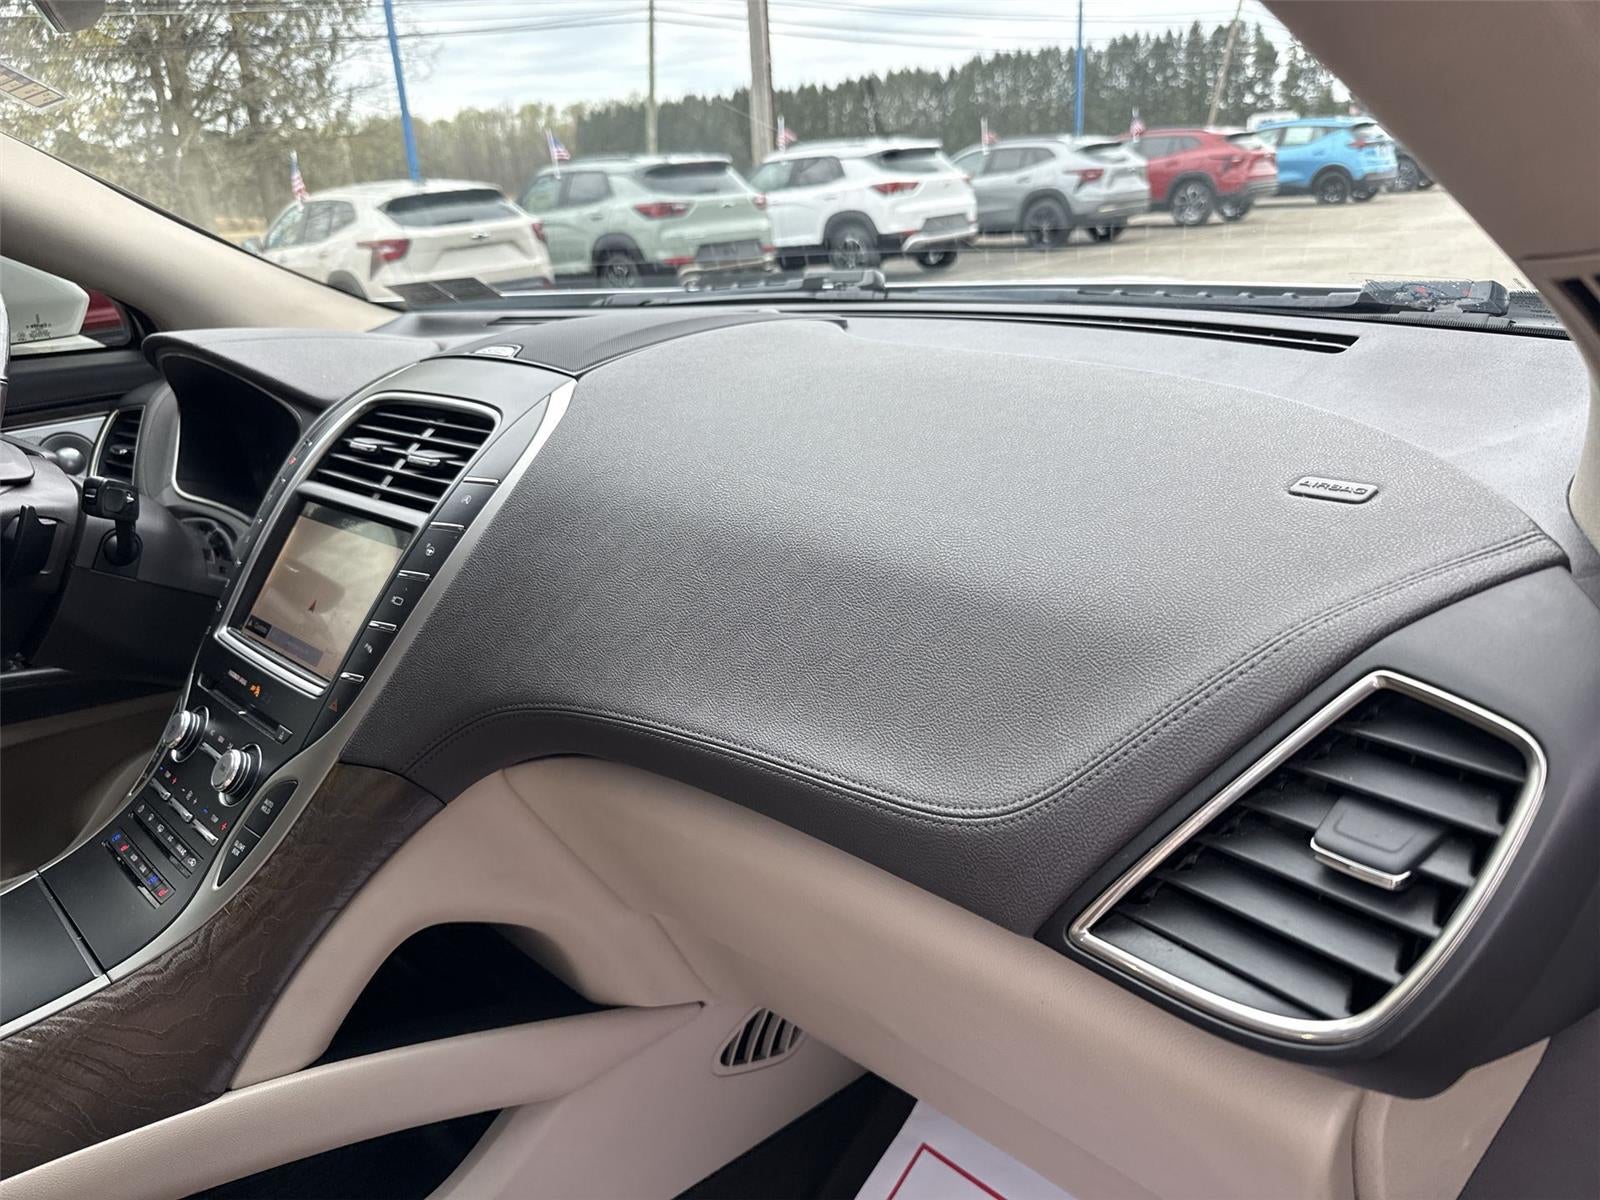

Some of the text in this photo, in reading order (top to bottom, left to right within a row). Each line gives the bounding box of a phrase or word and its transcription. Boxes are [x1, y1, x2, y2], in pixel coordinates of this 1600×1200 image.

[1299, 481, 1368, 495] AIRBAG
[263, 798, 275, 809] AUTO
[260, 805, 272, 815] HOLD
